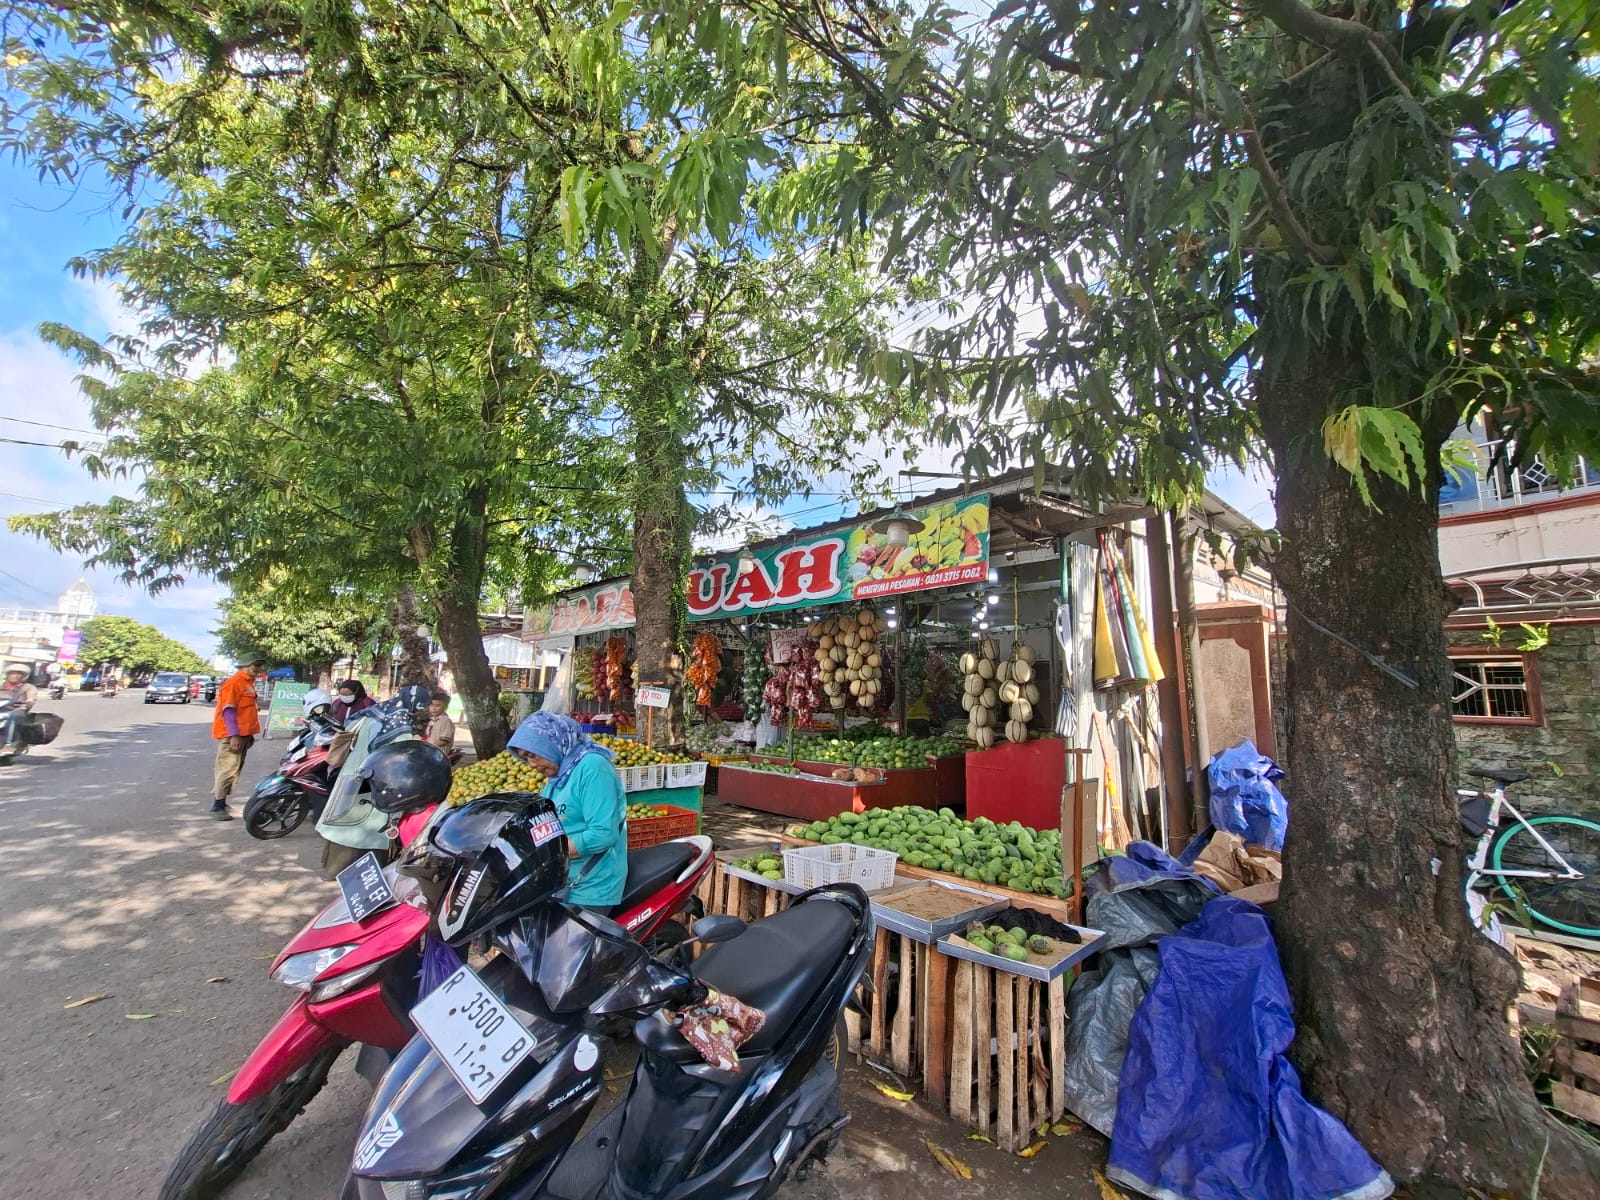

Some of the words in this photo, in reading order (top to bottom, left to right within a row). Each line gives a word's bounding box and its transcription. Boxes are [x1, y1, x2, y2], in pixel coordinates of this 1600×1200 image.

[925, 573, 942, 585] 0821
[943, 571, 960, 582] 3715
[961, 566, 981, 579] 1082
[356, 855, 370, 868] R
[369, 886, 388, 903] EF
[454, 869, 482, 907] YAMAHA
[442, 971, 465, 994] R
[461, 991, 505, 1038] 3500
[501, 1036, 526, 1063] B
